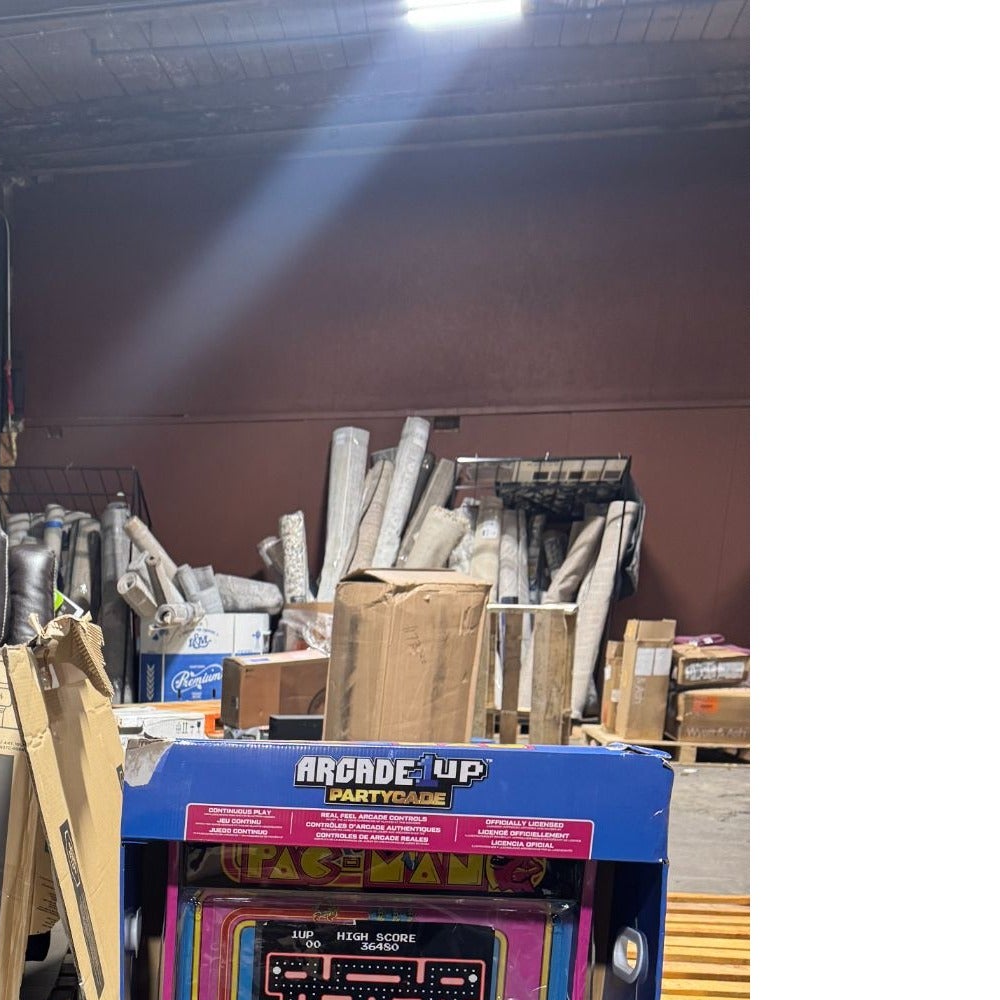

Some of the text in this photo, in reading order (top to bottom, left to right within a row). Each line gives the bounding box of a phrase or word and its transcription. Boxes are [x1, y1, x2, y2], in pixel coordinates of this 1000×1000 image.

[175, 669, 223, 689] Premium
[295, 752, 486, 788] ARCADE1UP
[328, 787, 448, 807] PARTYCADE
[208, 807, 272, 816] CONTINUOUS PLAY
[231, 818, 262, 826] CONTINU
[305, 821, 441, 833] CONTRÔLES D'ARCADE AUTHENTIQUES
[485, 819, 565, 829] OFFICIALLY LICENSED
[315, 832, 357, 840] CONTROLES
[369, 834, 400, 842] ARCADE
[509, 830, 570, 839] OFFICIELLEMENT
[490, 839, 525, 847] LICENCIA
[525, 841, 555, 849] OFICIAL
[291, 930, 417, 943] 1UP HIGH SCORE
[305, 939, 400, 952] 00 36480
